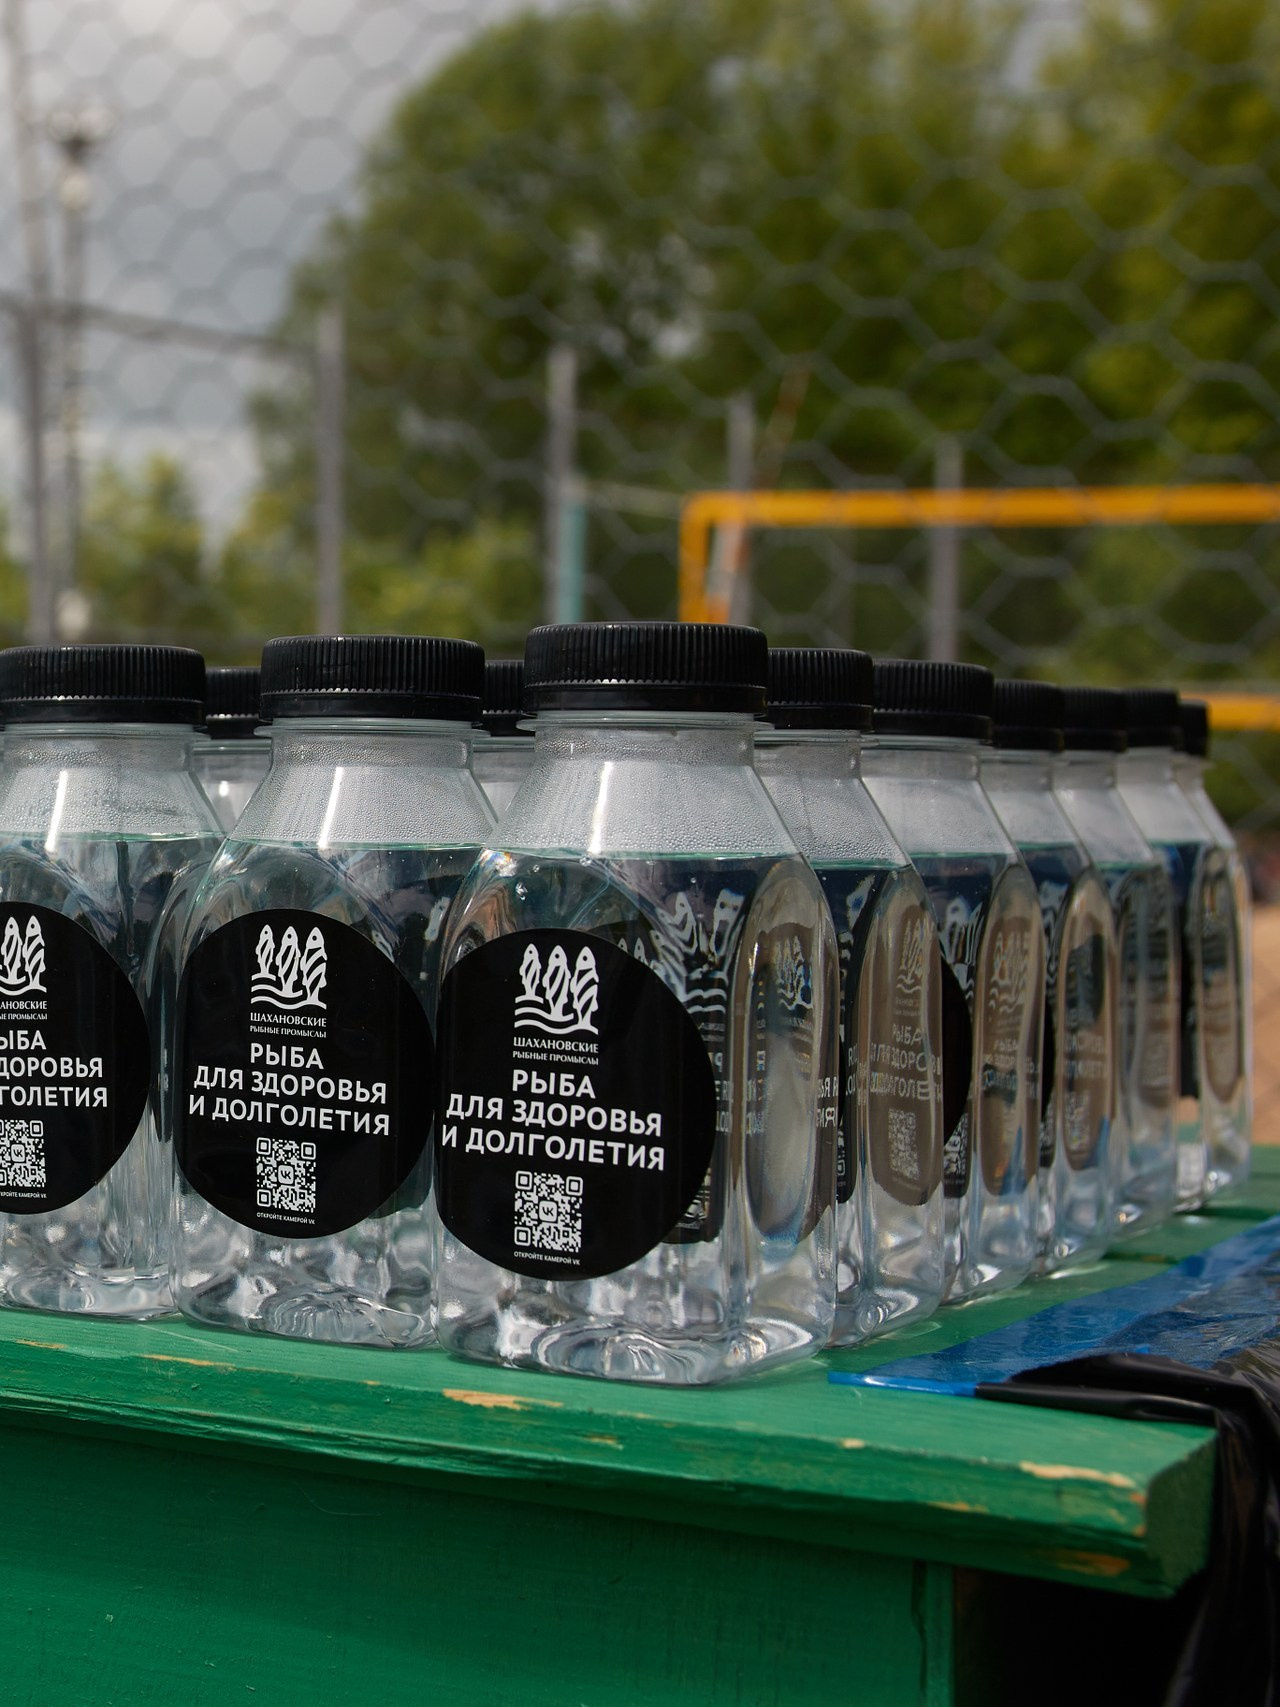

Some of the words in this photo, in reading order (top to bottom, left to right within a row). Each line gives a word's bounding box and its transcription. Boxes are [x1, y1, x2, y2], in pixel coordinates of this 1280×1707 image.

[250, 1012, 327, 1028] ШАХАНОВСКИЕ
[250, 1025, 279, 1035] РЫБНЫЕ
[281, 1027, 327, 1038] ПРОМЫСЛЫ
[513, 1036, 599, 1054] ШАХАНОВСКИЕ
[250, 1042, 324, 1070] РЫБА
[512, 1051, 548, 1061] РЫБНЫЕ
[549, 1053, 599, 1065] ПРОМЫСЛЫ
[193, 1065, 243, 1090] ДЛЯ
[251, 1070, 387, 1105] ЗДОРОВЬЯ
[512, 1069, 596, 1099] РЫБА
[189, 1094, 205, 1116] И
[212, 1097, 390, 1136] ДОЛГОЛЕТИЯ
[446, 1093, 503, 1120] ДЛЯ
[511, 1099, 661, 1137] ЗДОРОВЬЯ
[442, 1124, 457, 1148] И
[465, 1128, 664, 1171] ДОЛГОЛЕТИЯ
[18, 1191, 40, 1199] КАМЕРОЙ
[256, 1212, 283, 1221] ОТКРОЙТЕ
[283, 1214, 308, 1224] КАМЕРОЙ
[514, 1251, 544, 1260] ОТКРОЙТЕ
[544, 1254, 572, 1264] КАМЕРОЙ
